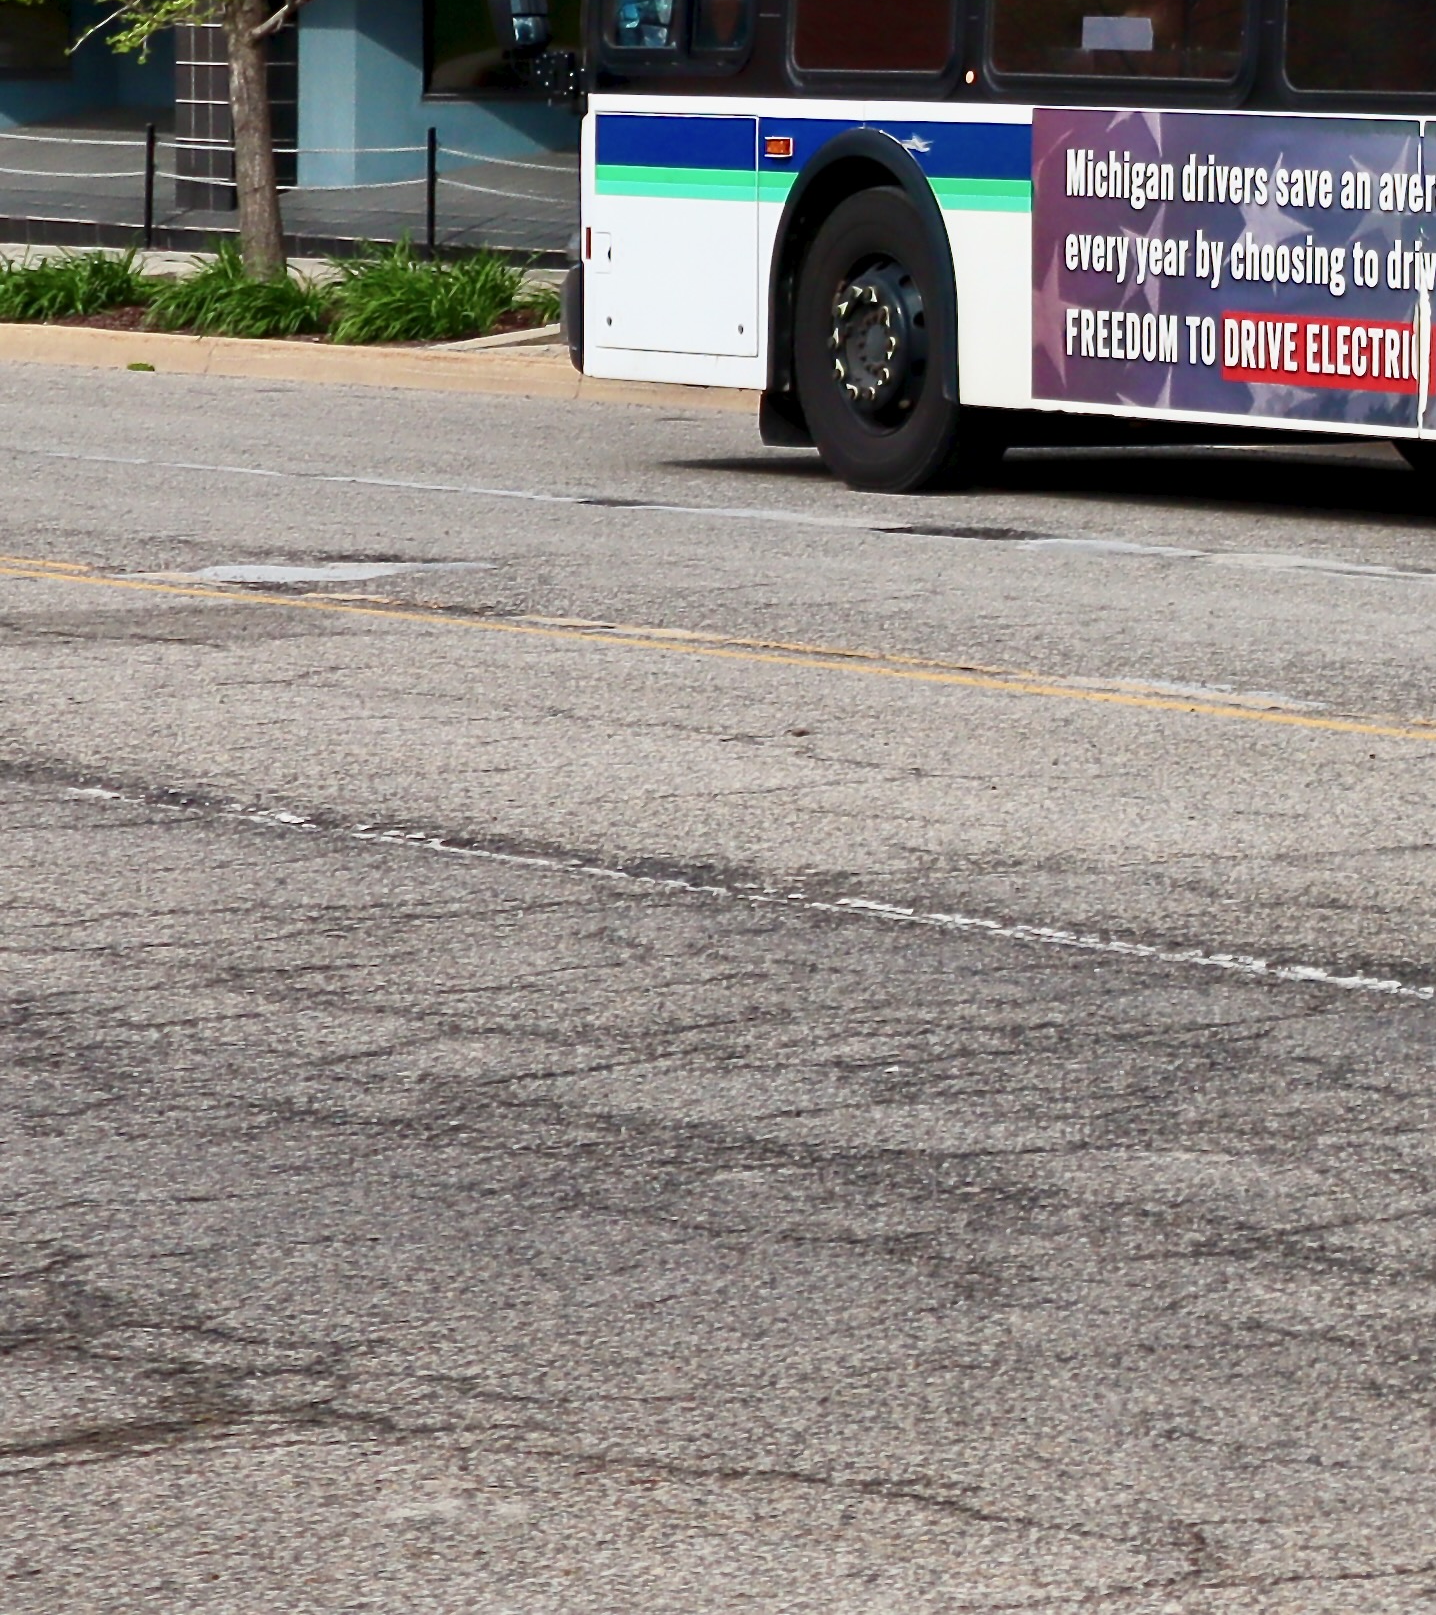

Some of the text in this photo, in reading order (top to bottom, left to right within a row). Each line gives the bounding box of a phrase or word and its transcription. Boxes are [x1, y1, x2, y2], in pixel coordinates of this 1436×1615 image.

[1066, 149, 1174, 210] Michigan
[1182, 153, 1268, 206] drivers
[1275, 168, 1333, 208] save
[1340, 171, 1371, 210] an
[1065, 233, 1129, 283] every
[1136, 236, 1189, 285] year
[1195, 229, 1224, 289] by
[1231, 232, 1346, 296] choosing
[1352, 241, 1379, 288] to
[1066, 308, 1178, 363] FREEDOM
[1185, 316, 1216, 366] TO
[1224, 318, 1298, 371] DRIVE
